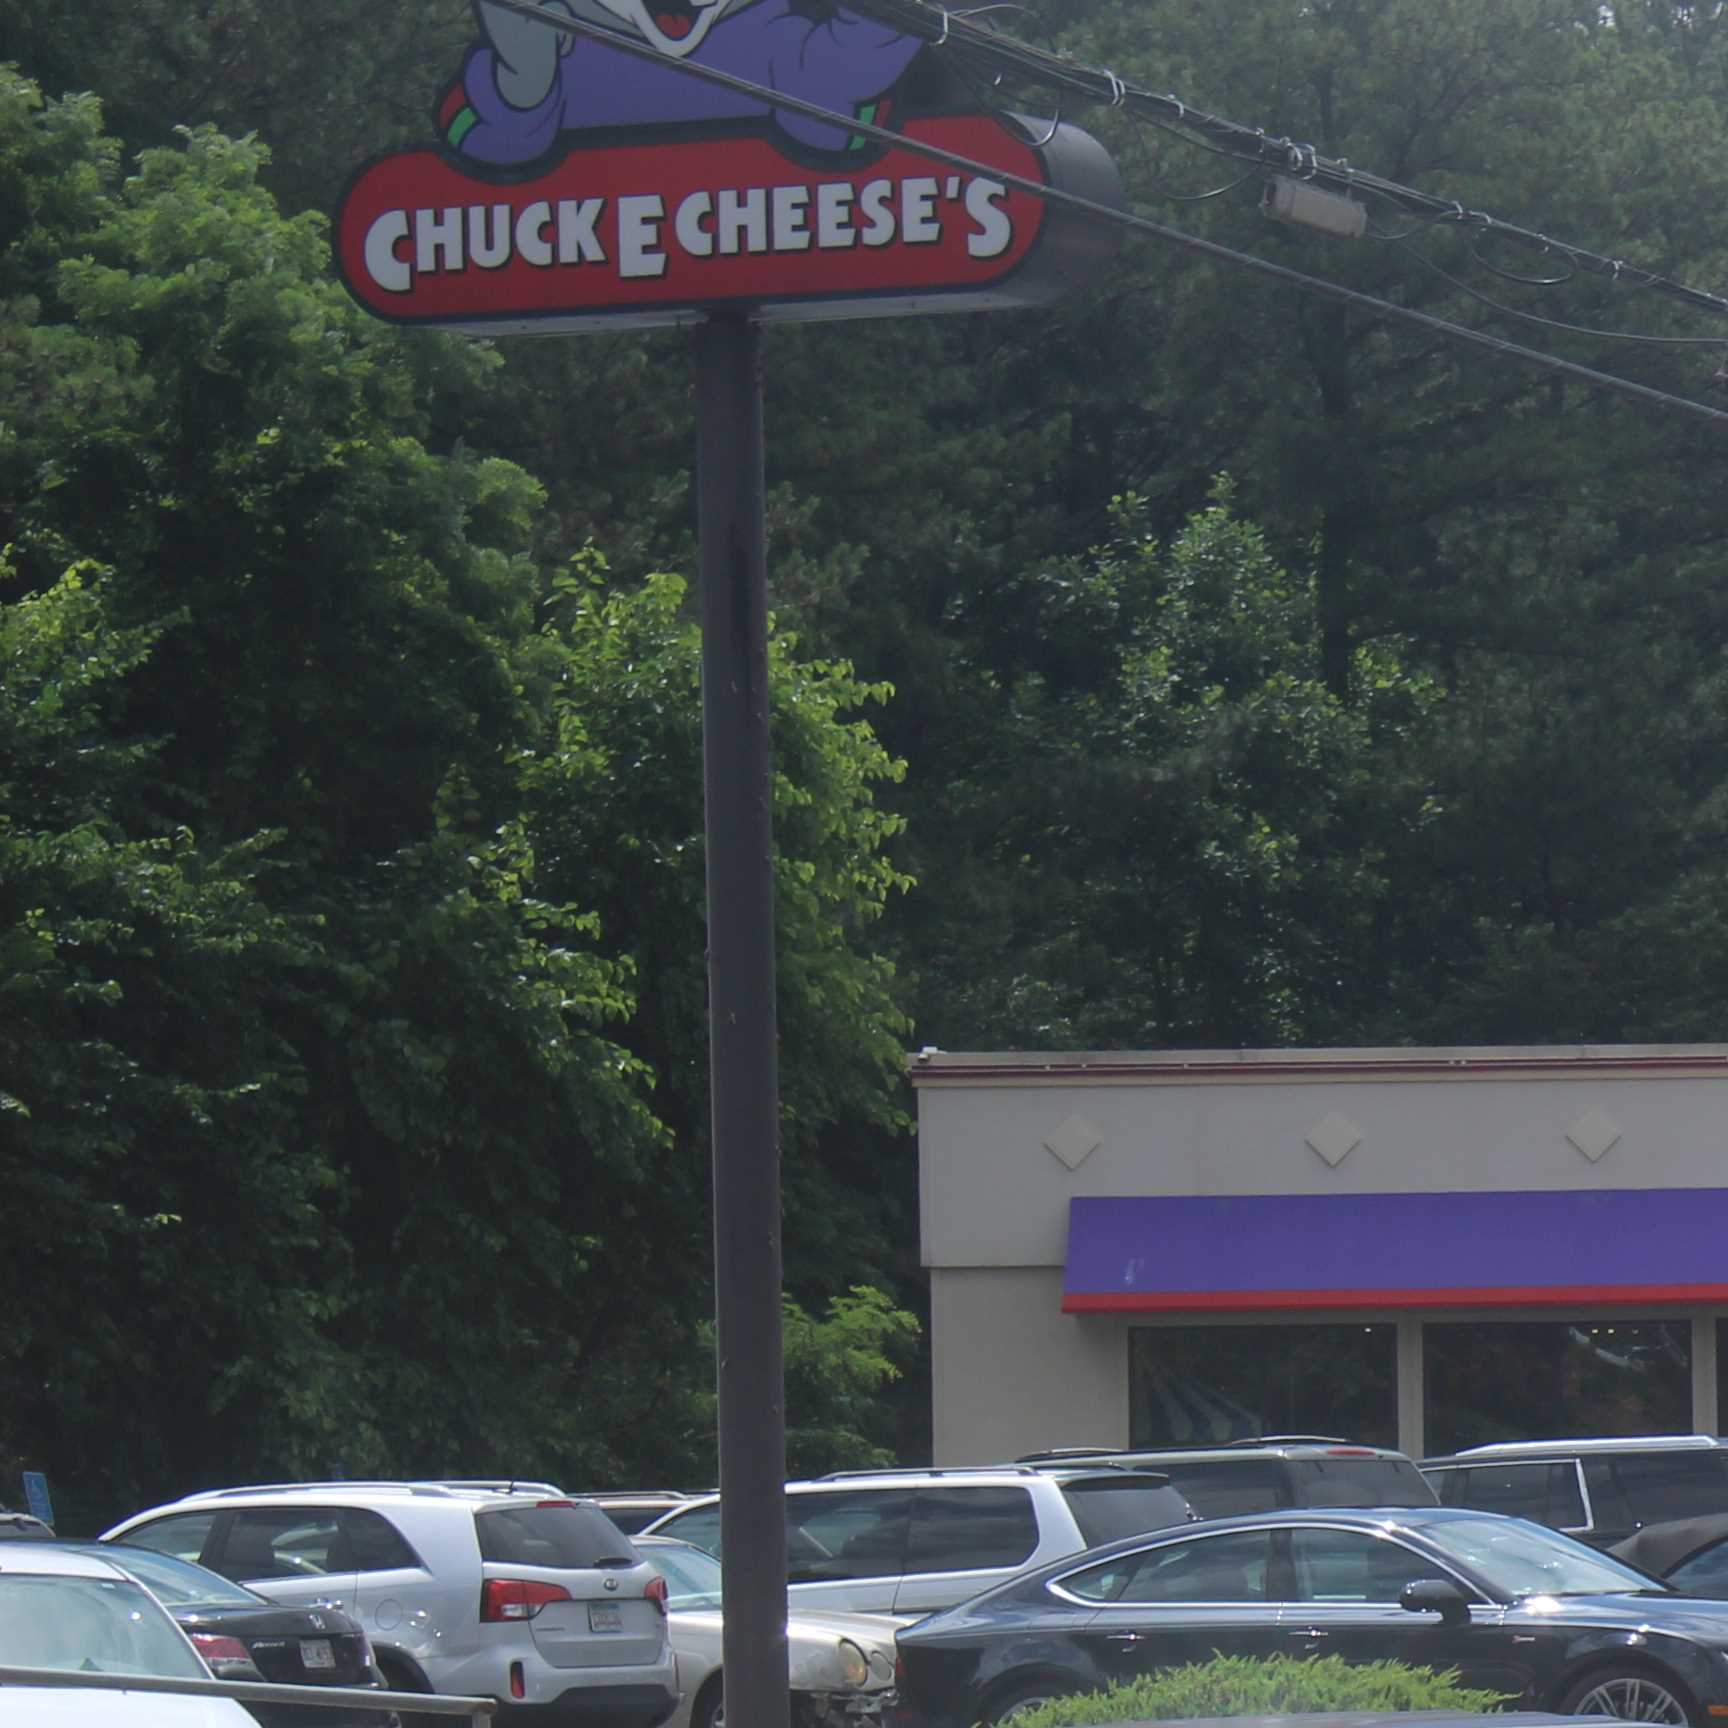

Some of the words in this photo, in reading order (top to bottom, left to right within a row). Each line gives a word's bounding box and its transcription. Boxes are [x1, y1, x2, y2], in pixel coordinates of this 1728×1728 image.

[364, 199, 605, 291] CHUCK
[618, 194, 668, 278] E
[675, 175, 1012, 258] CHEESE'S
